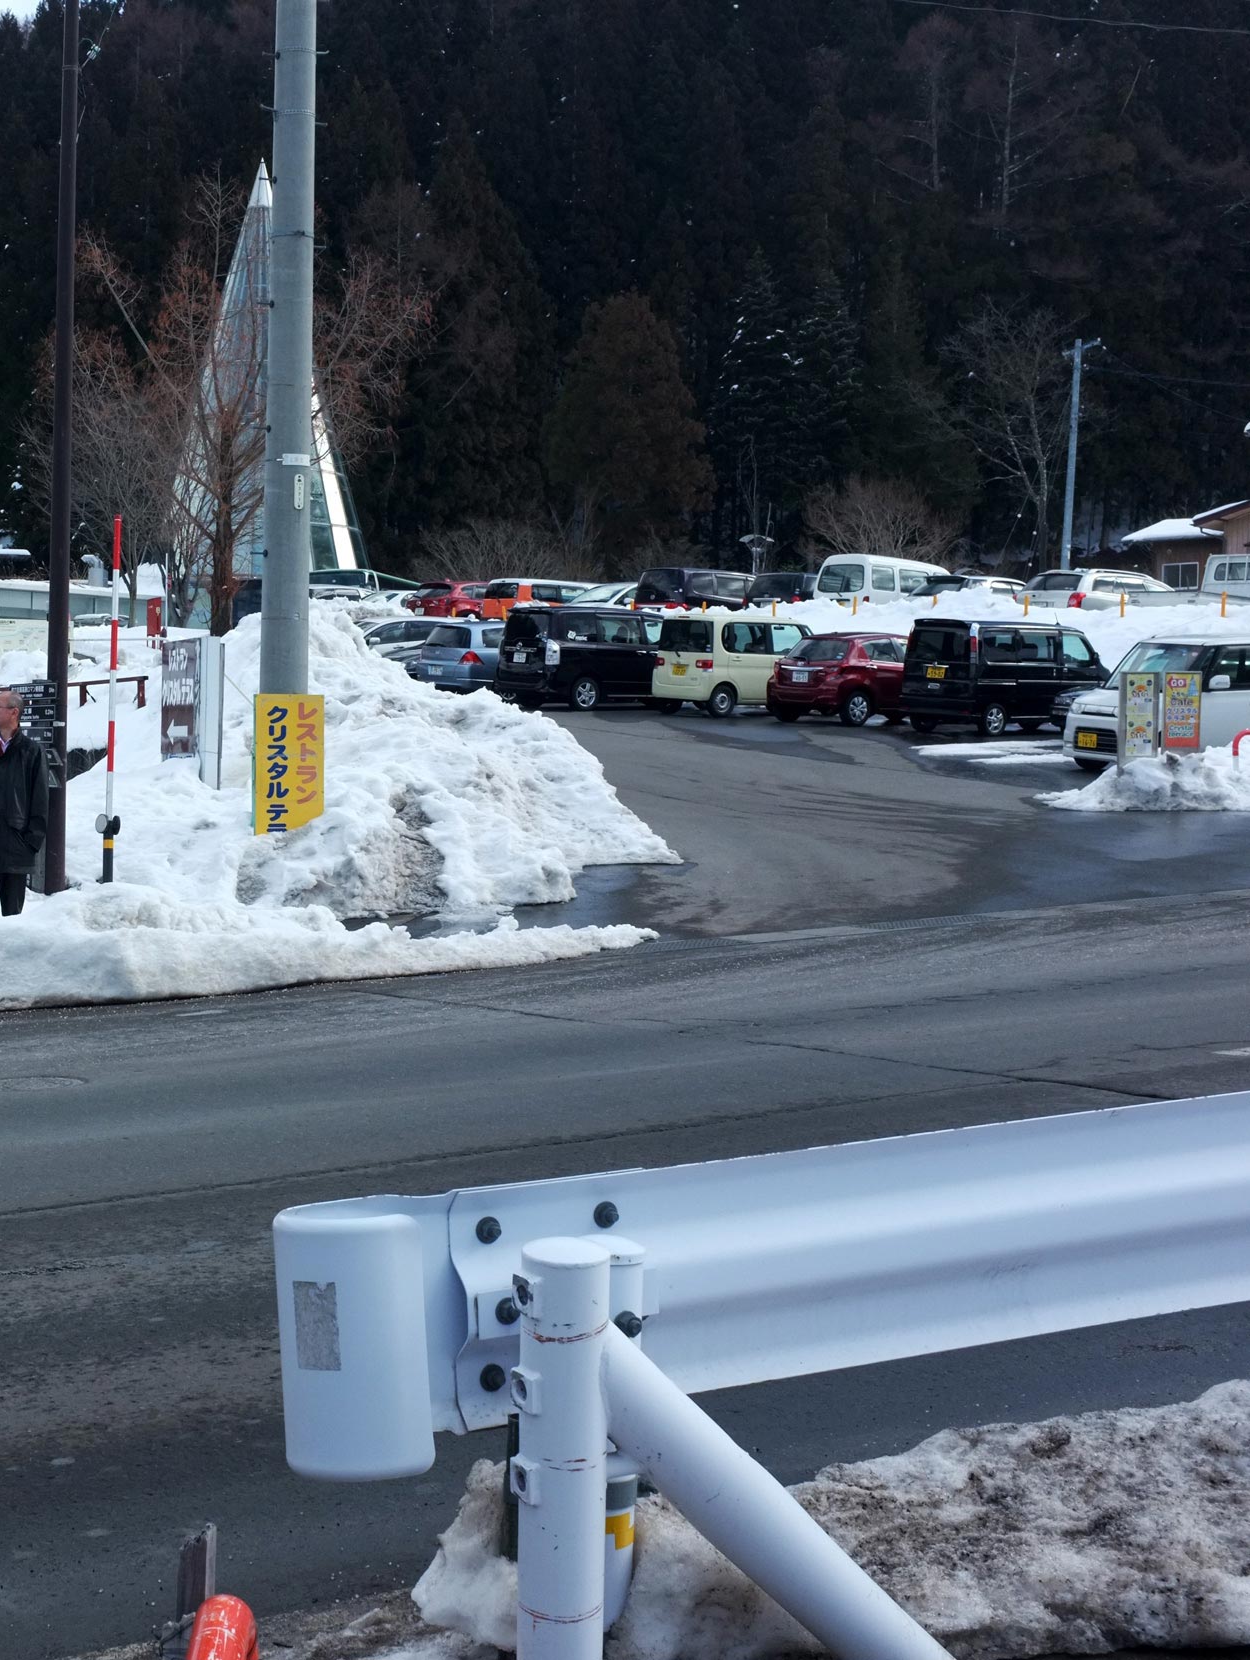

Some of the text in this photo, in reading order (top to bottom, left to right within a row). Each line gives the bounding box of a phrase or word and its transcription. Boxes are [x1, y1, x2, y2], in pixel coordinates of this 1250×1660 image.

[1170, 679, 1185, 687] GO
[296, 702, 318, 805] レストラン
